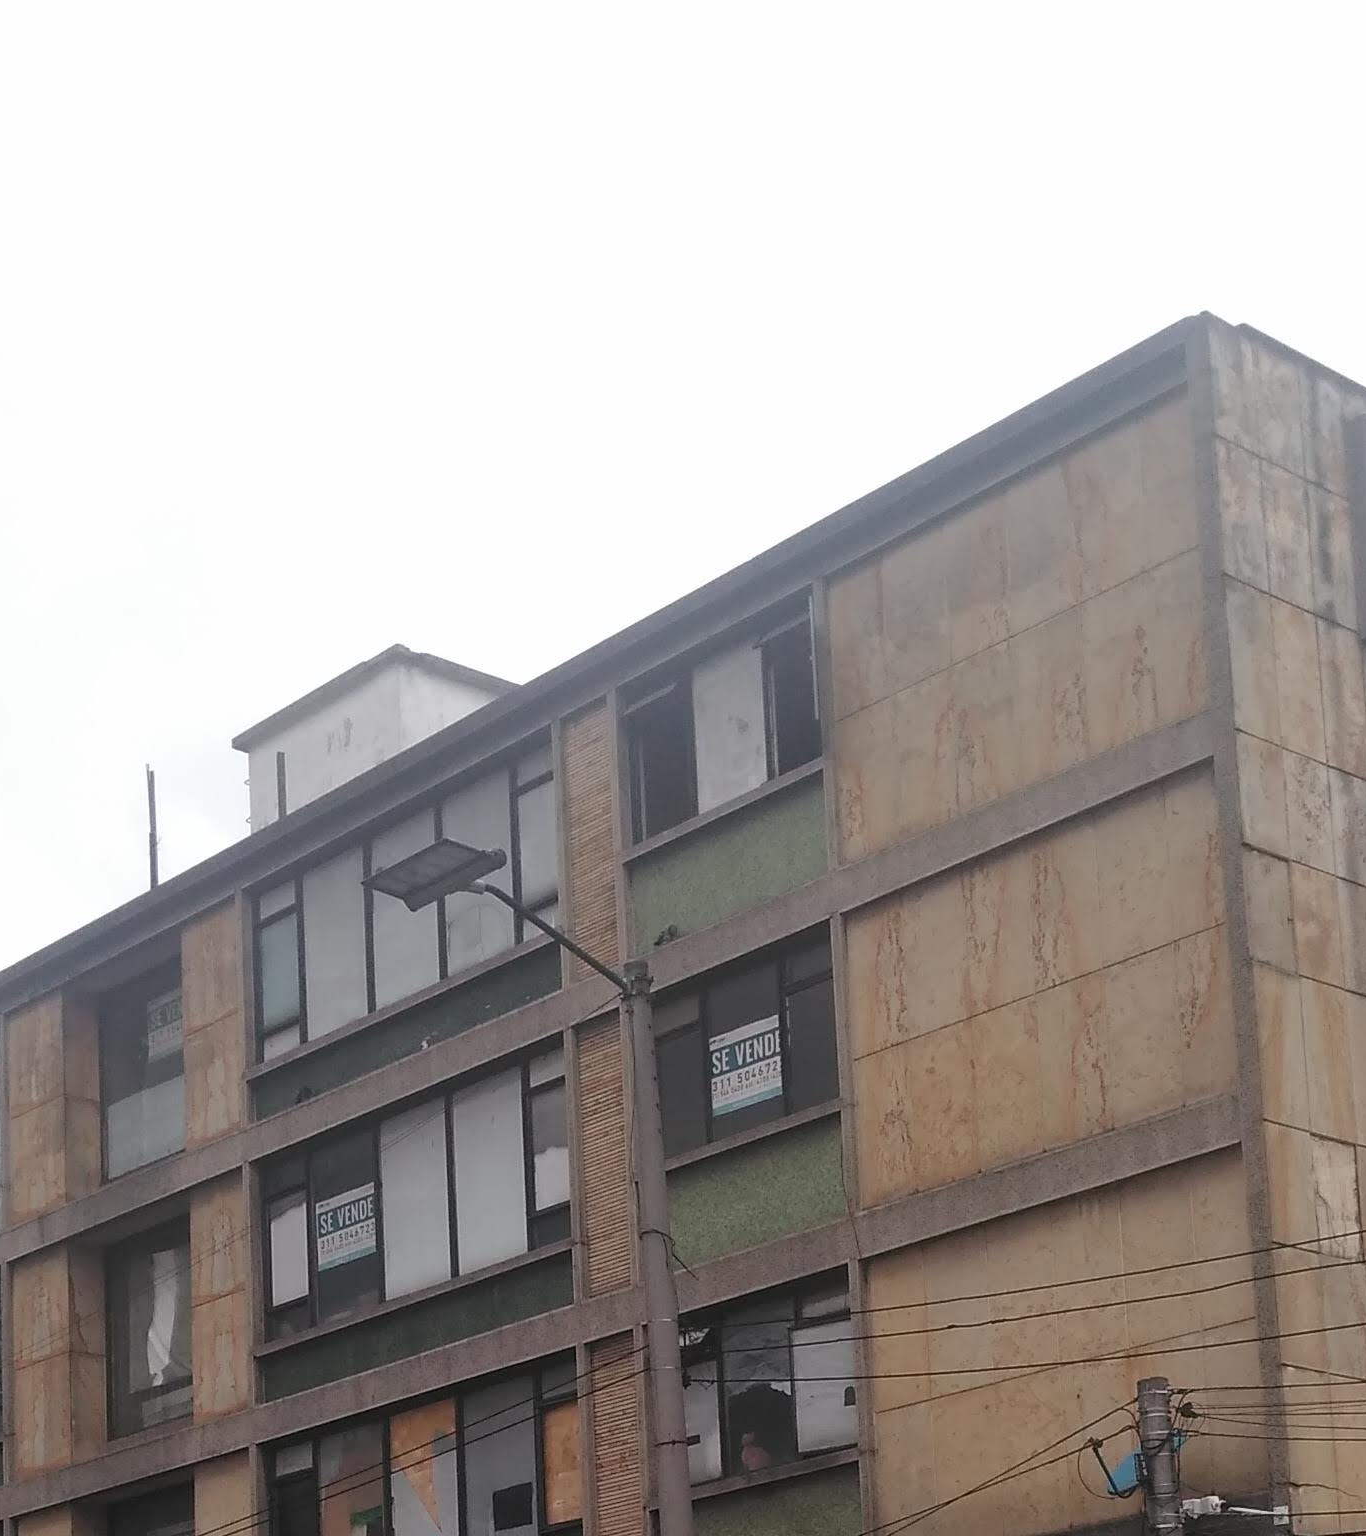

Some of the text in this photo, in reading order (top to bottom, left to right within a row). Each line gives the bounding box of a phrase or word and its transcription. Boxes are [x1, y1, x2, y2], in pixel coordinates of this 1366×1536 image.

[712, 1048, 731, 1075] SE
[737, 1061, 780, 1084] 504672
[320, 1196, 374, 1234] SE VENDE
